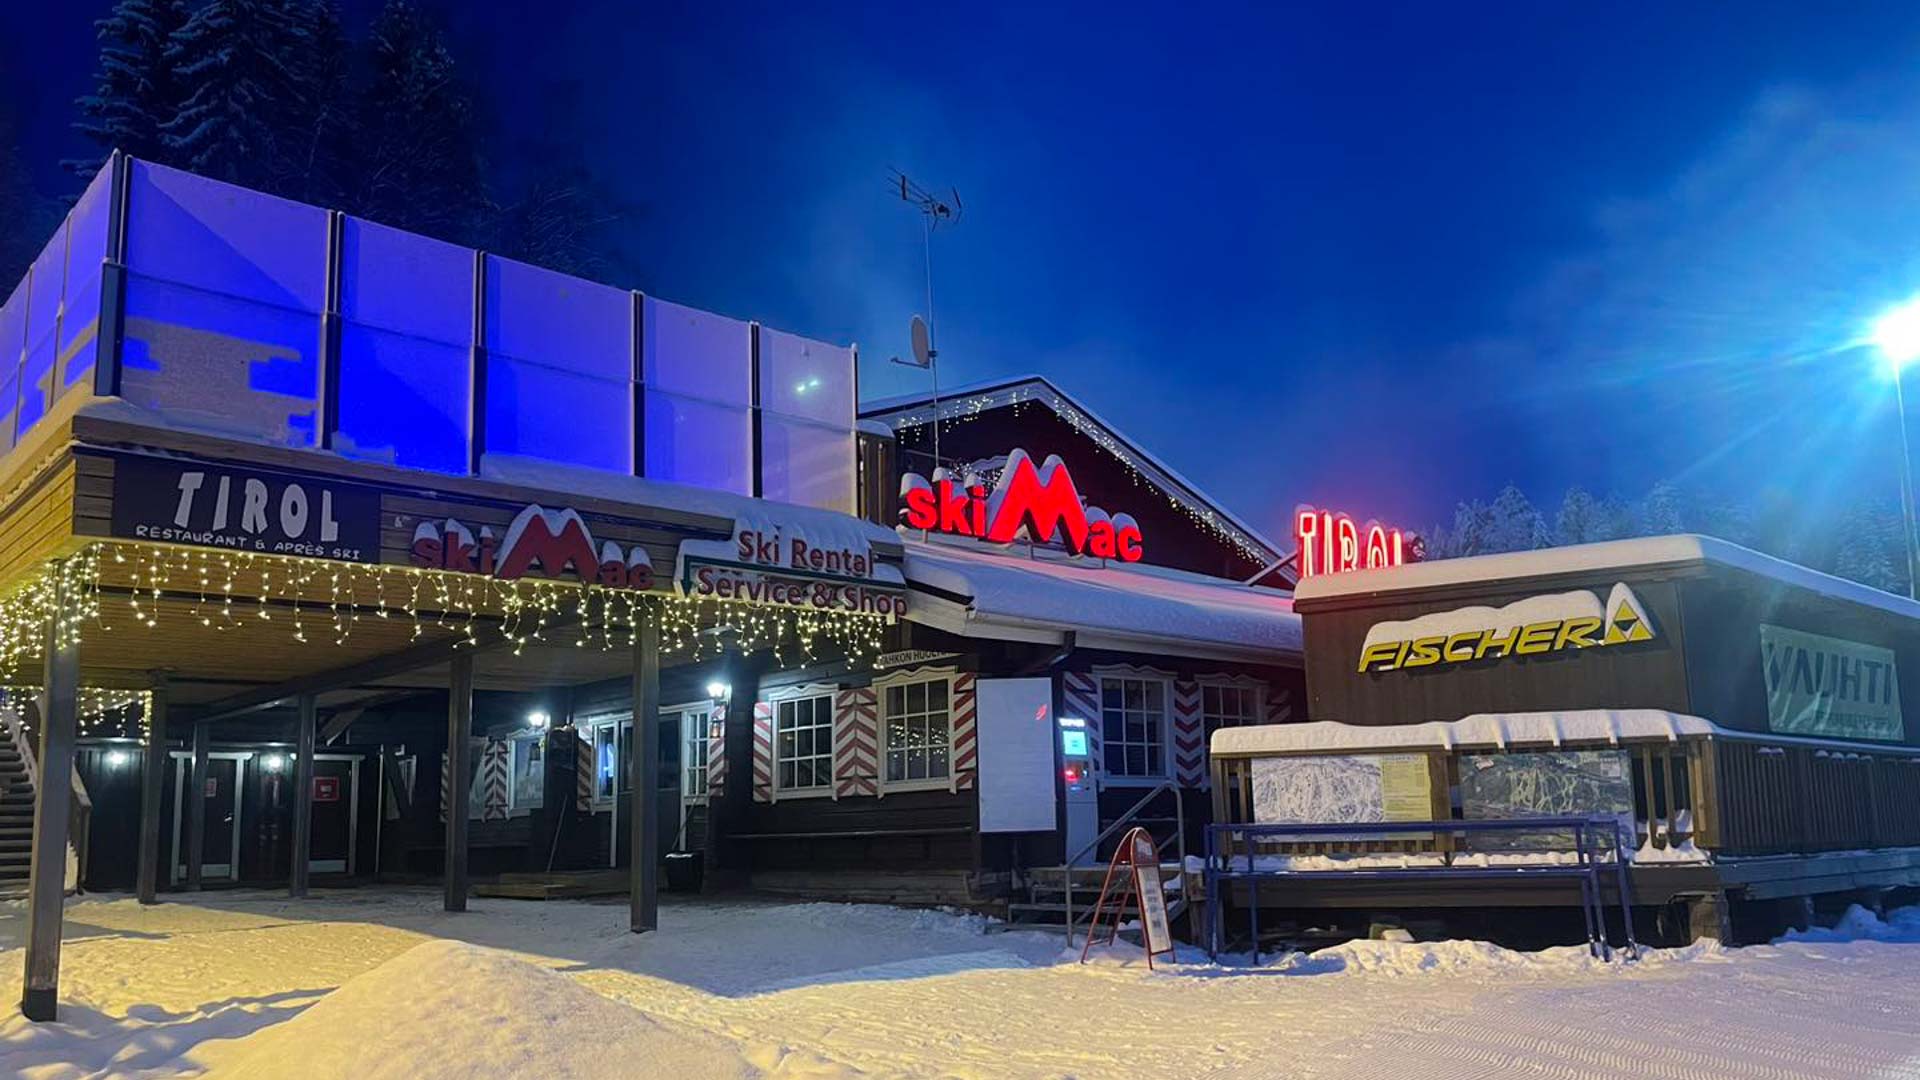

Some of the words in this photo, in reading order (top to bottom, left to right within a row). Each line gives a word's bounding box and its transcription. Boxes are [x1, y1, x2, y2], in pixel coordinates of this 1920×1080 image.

[174, 472, 338, 542] TIROL
[136, 525, 247, 548] RESTAURANT
[255, 538, 265, 549] &
[275, 541, 324, 556] APRÈS
[738, 531, 780, 565] Ski
[791, 538, 874, 578] Rental
[697, 566, 801, 605] Service
[812, 581, 837, 609] &
[844, 585, 908, 622] Shop
[1357, 616, 1603, 673] FISCHER
